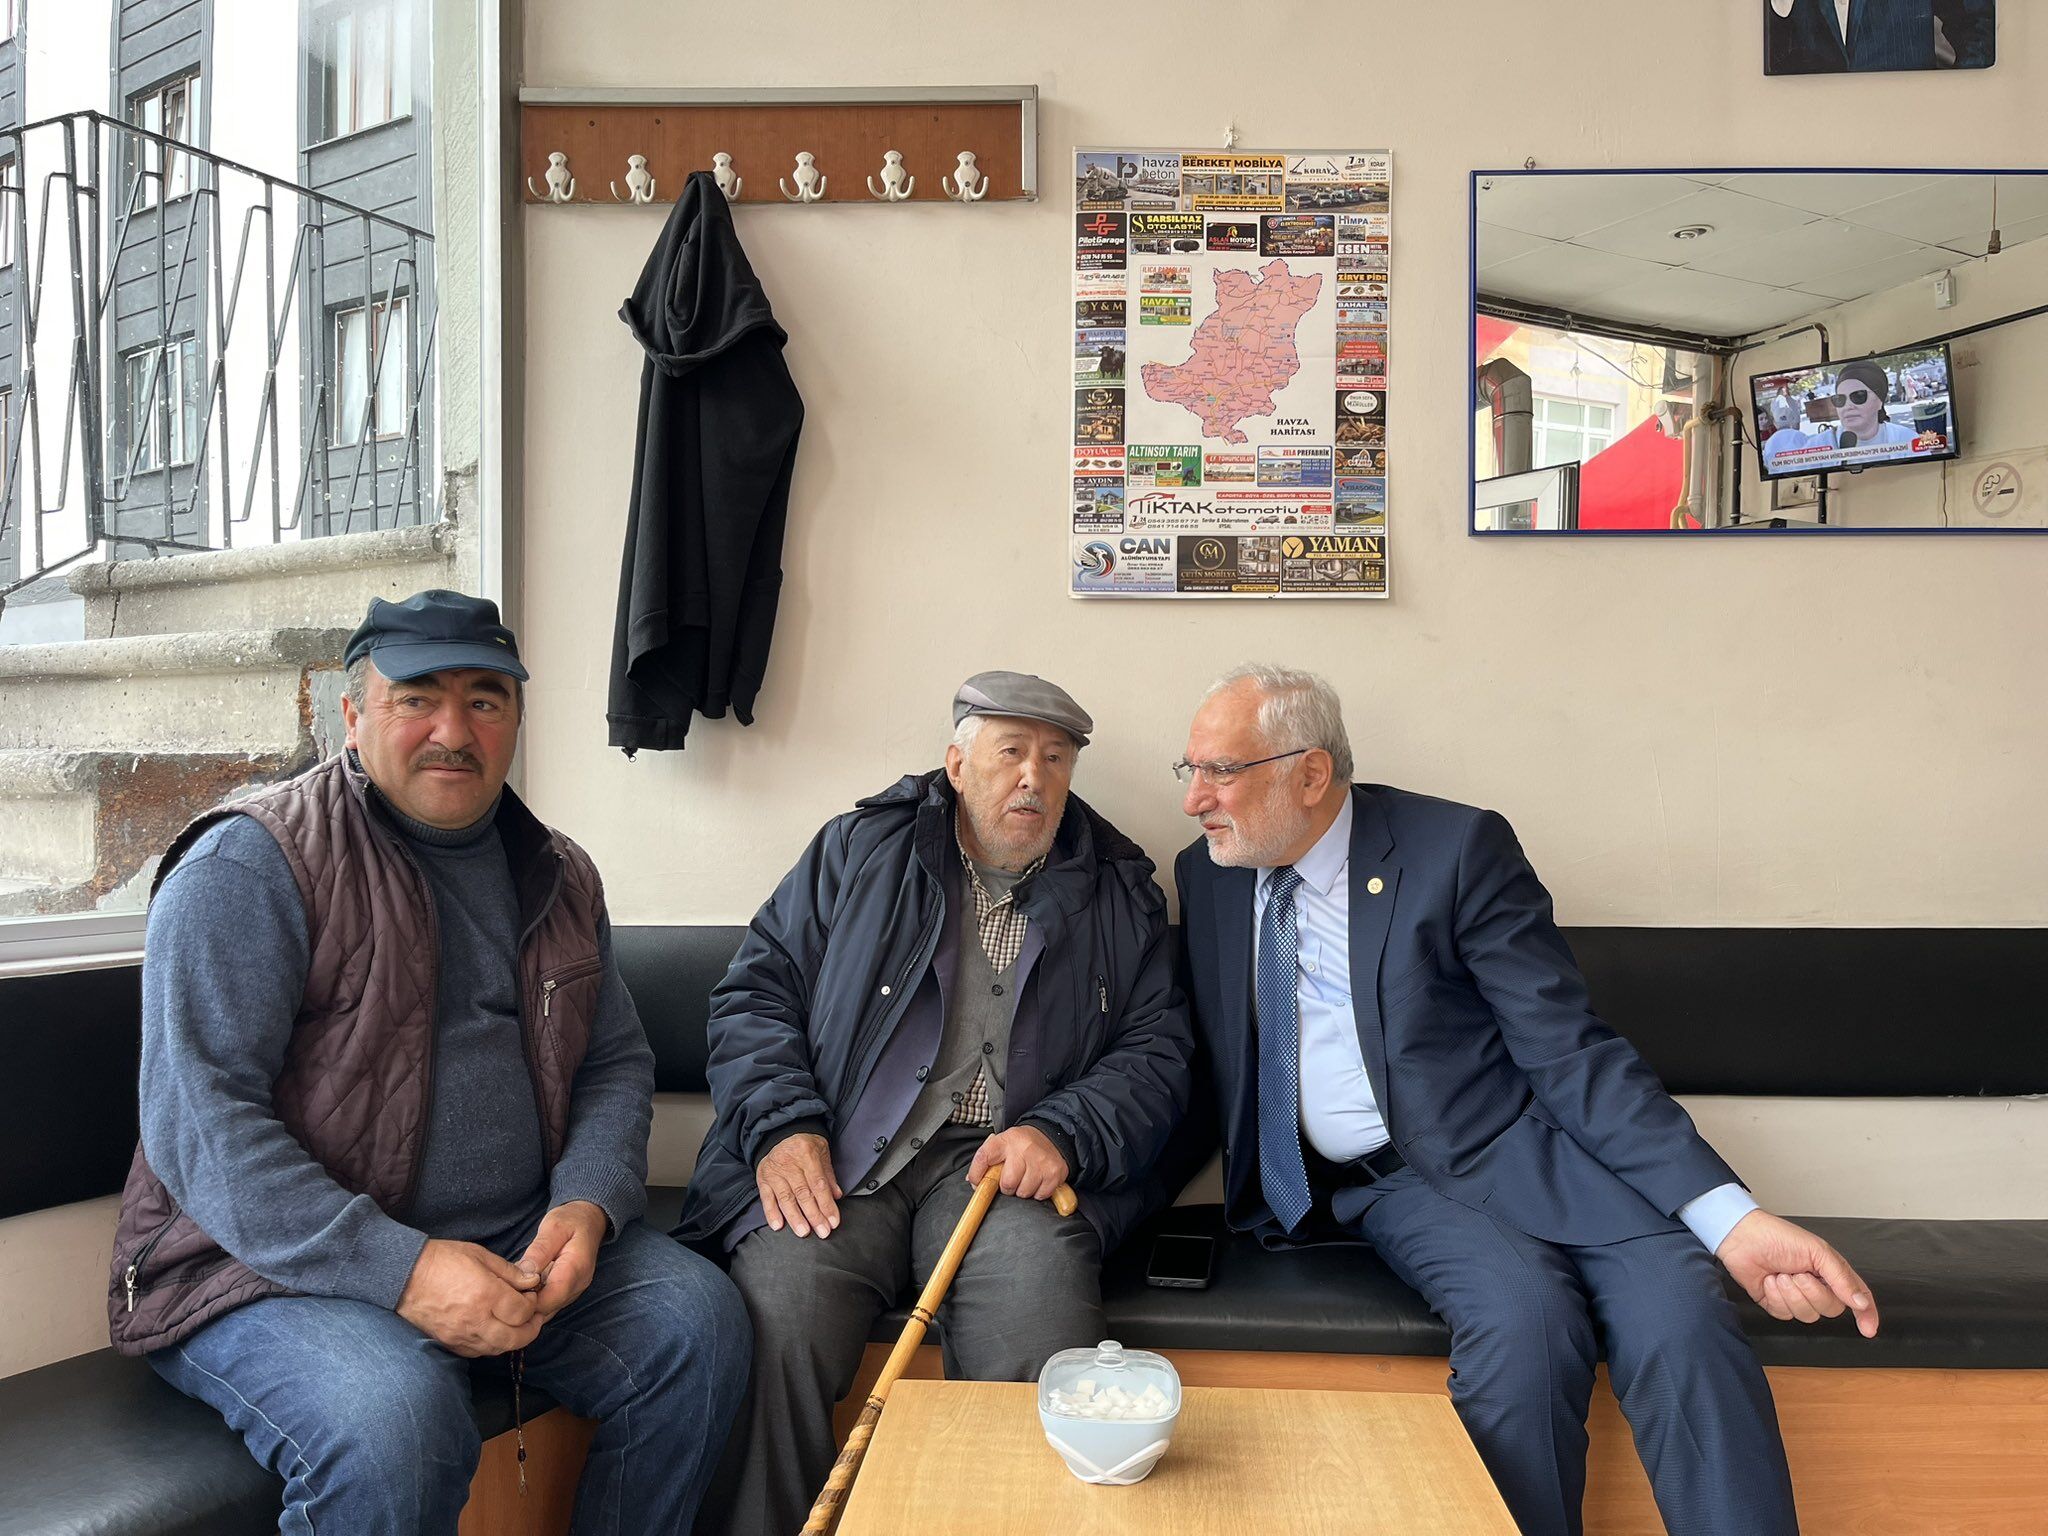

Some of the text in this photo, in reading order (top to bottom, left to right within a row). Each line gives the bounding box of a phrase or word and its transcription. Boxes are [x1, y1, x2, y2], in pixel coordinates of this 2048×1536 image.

[1142, 156, 1179, 168] havza
[1182, 158, 1283, 168] BEREKET MOBİLYA
[1142, 168, 1176, 179] beton
[1147, 215, 1202, 223] SARSILMAZ
[1338, 244, 1370, 254] ESEN
[1338, 273, 1387, 281] ZİRVE PİDE
[1091, 302, 1123, 311] Y & M
[1141, 298, 1175, 306] HAVZA
[1270, 427, 1316, 436] HARİTASI
[1076, 447, 1110, 456] DOYUM
[1129, 446, 1171, 457] ALTINSOY
[1173, 447, 1199, 457] TARIM
[1297, 449, 1330, 457] PREFABRİK
[1119, 537, 1171, 555] CAN
[1308, 536, 1380, 552] YAMAN
[1204, 570, 1237, 578] MOBİLYA
